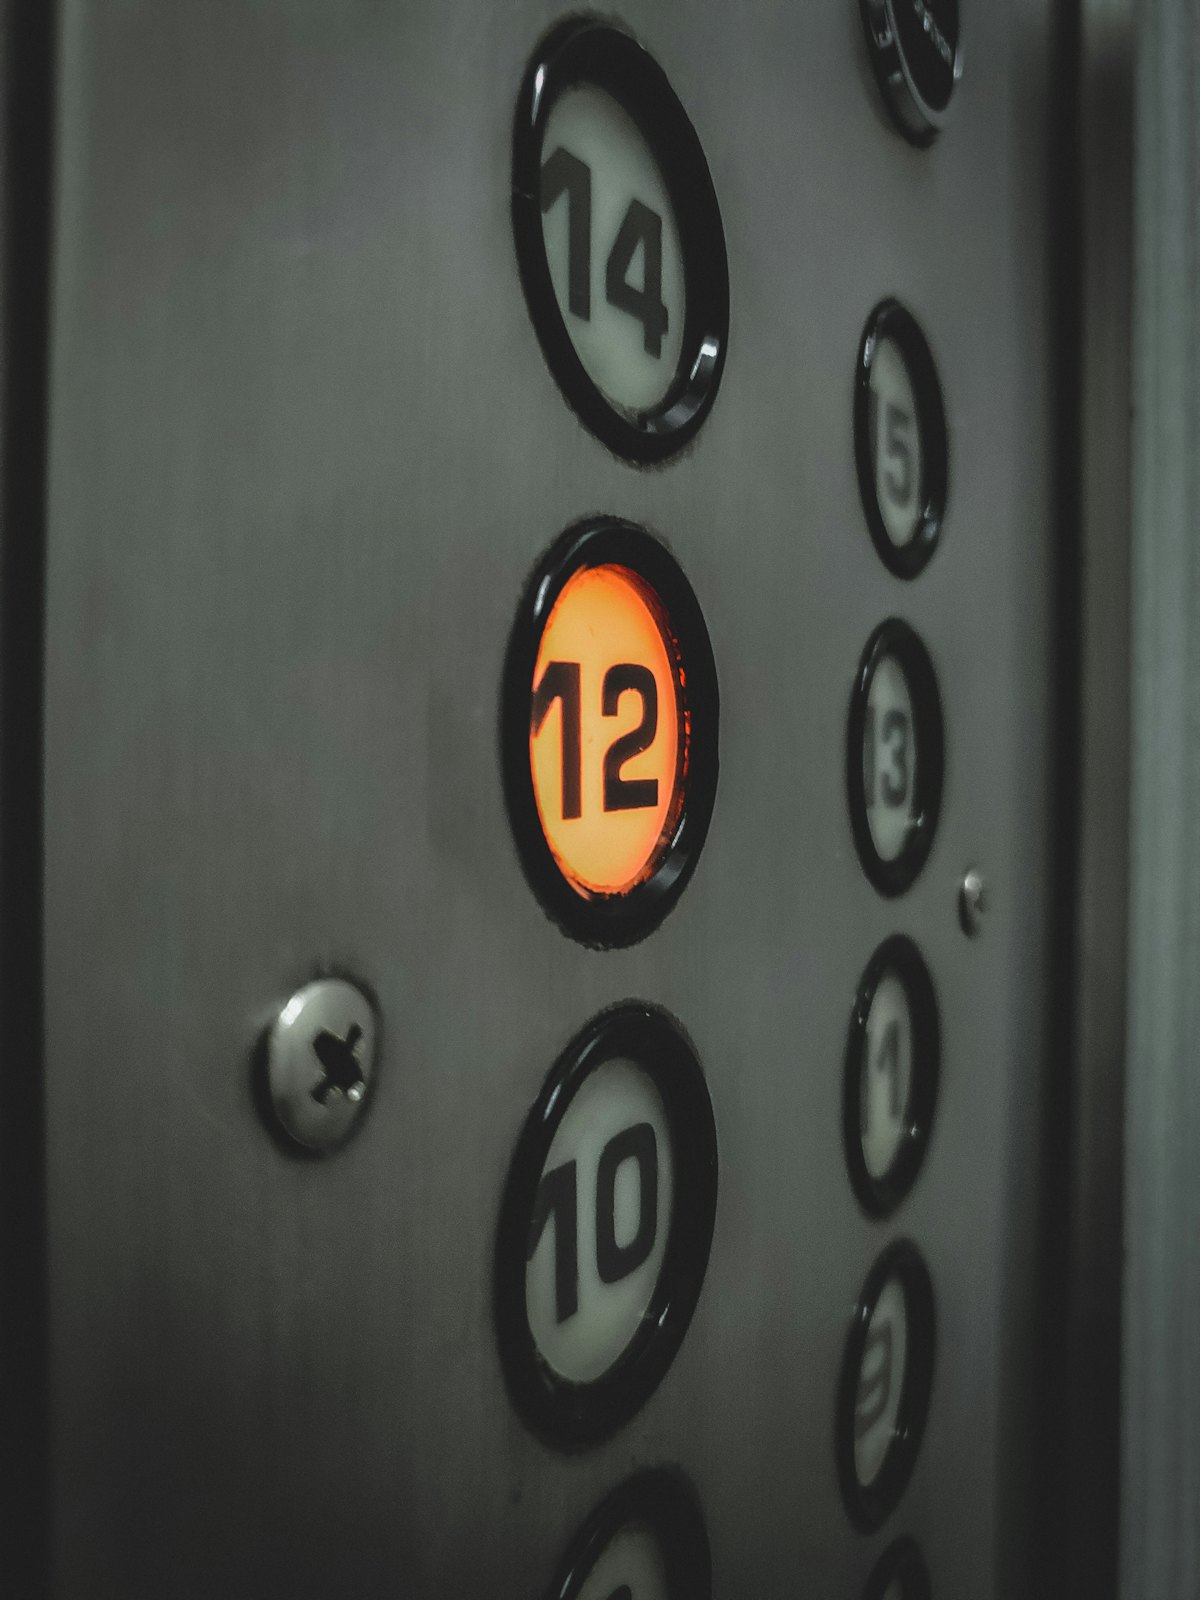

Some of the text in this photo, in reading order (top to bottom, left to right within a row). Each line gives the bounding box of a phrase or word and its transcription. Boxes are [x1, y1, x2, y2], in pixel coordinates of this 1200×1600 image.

[540, 146, 668, 359] 14
[531, 660, 659, 820] 12
[526, 1121, 658, 1325] 10
